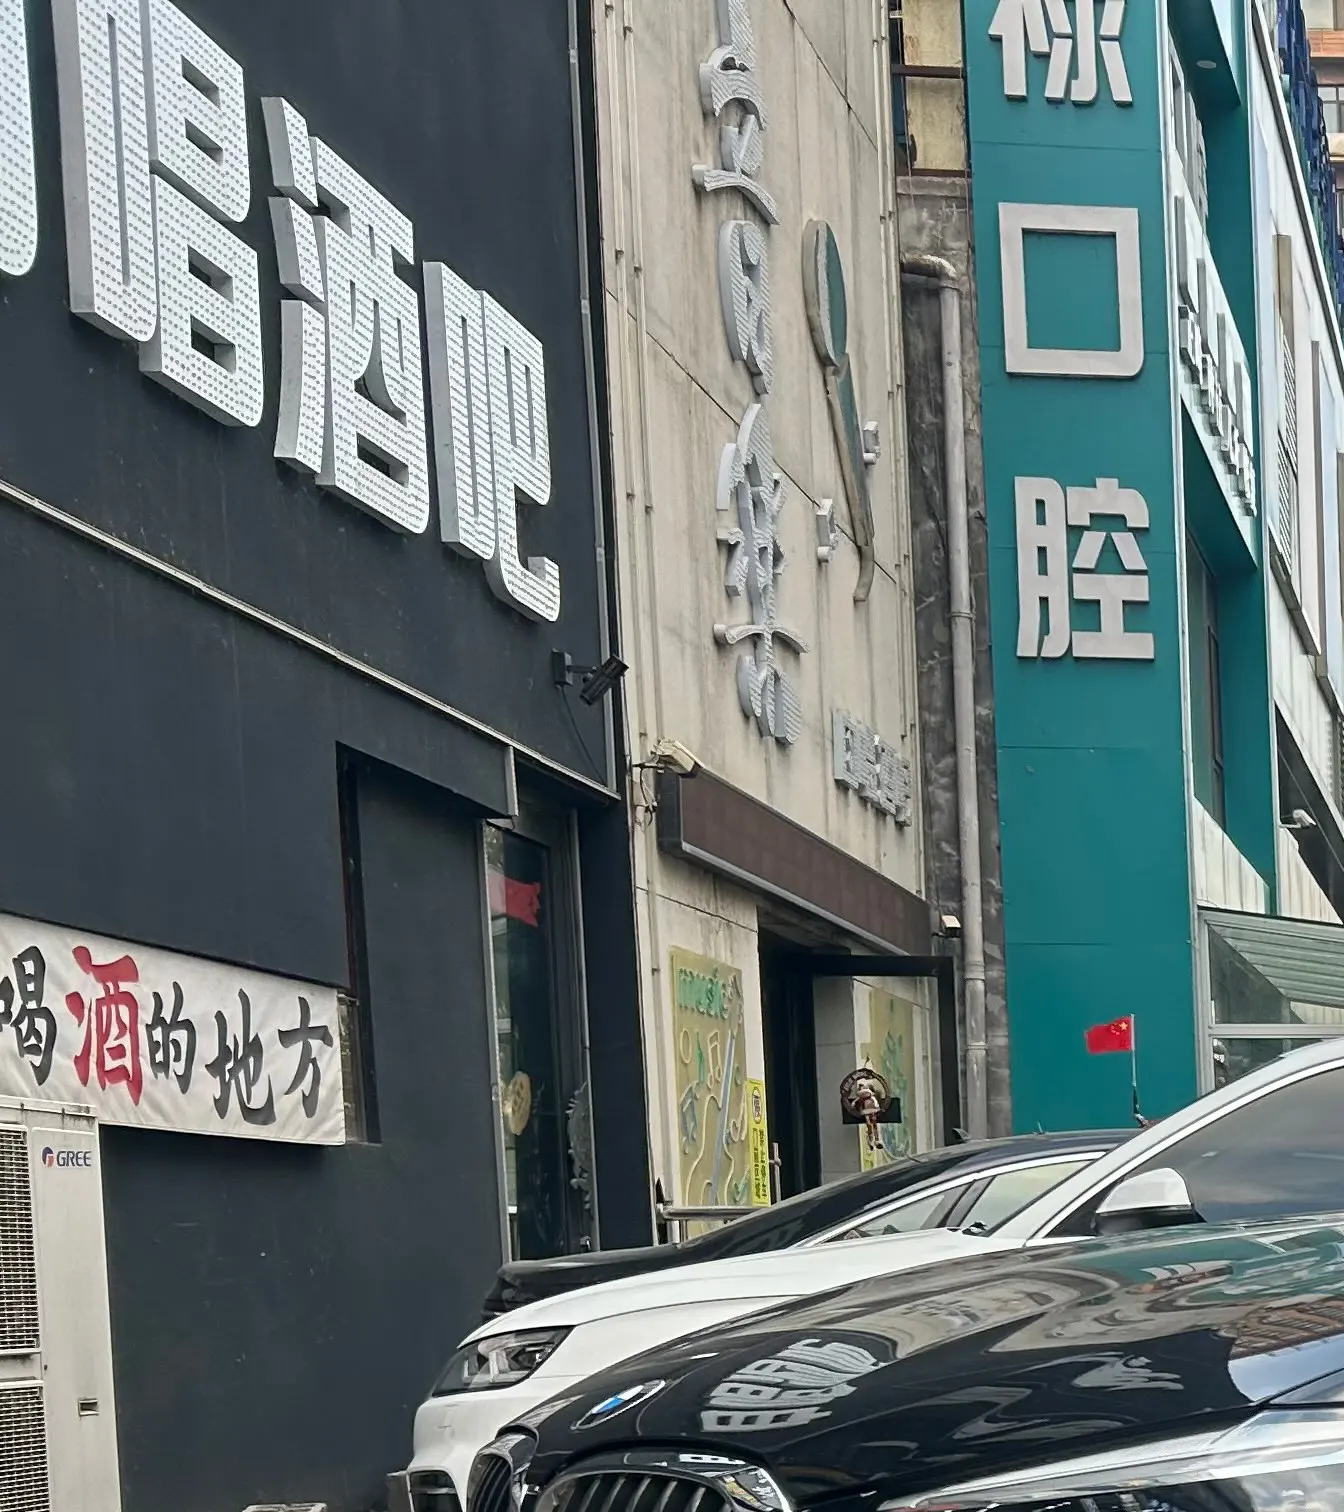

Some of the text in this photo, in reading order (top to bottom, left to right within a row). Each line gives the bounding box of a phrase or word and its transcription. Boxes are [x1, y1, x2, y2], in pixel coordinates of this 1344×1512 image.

[0, 0, 559, 622] 唱酒吧
[56, 1151, 92, 1167] GREE
